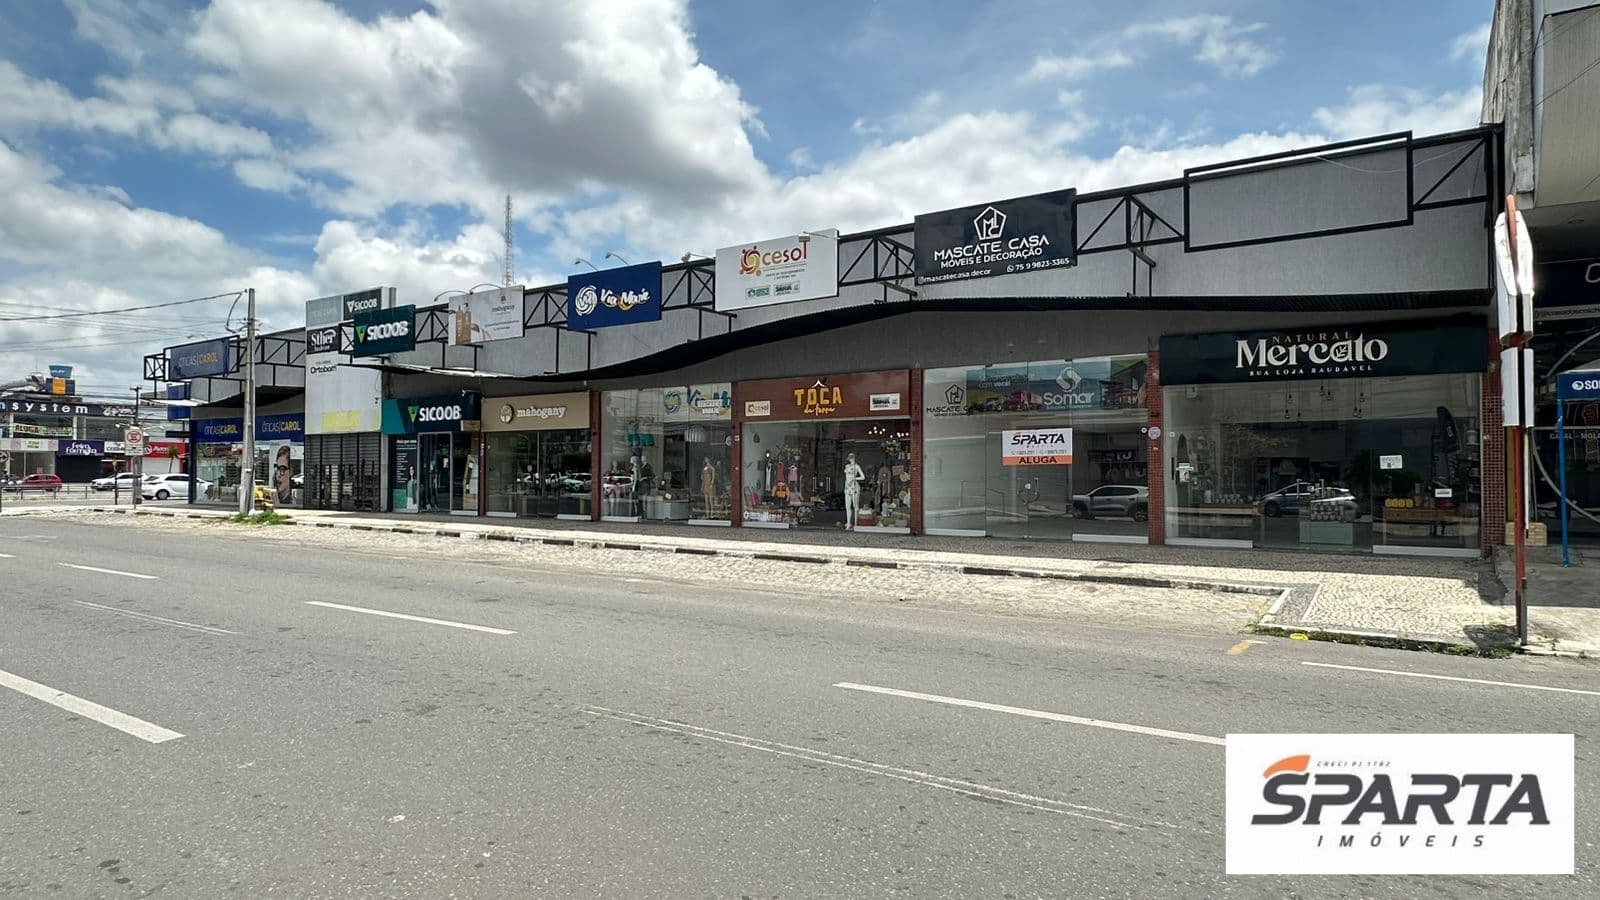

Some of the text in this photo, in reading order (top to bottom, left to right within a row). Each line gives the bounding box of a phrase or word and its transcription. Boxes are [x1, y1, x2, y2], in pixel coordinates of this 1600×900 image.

[762, 240, 807, 266] cesol
[934, 234, 1050, 261] MASCATE CASA
[940, 246, 1042, 269] MÓVEIS E DECORAÇÃO
[1015, 263, 1025, 271] 75
[1025, 262, 1031, 270] 9
[600, 287, 618, 306] Via
[354, 298, 378, 311] SICOOB
[367, 320, 409, 341] SICOOB
[1271, 331, 1352, 344] NATURAL
[199, 351, 218, 364] CAROL
[1275, 367, 1304, 376] LOJA
[1584, 380, 1600, 390] SO
[794, 385, 843, 406] TOCA
[1043, 391, 1095, 406] Somar
[419, 405, 462, 423] SICOOB
[516, 405, 567, 419] mahogany
[220, 424, 238, 434] CAROL
[280, 421, 302, 432] CAROL
[1011, 433, 1065, 446] SPARTA
[1018, 456, 1057, 464] ALUGA
